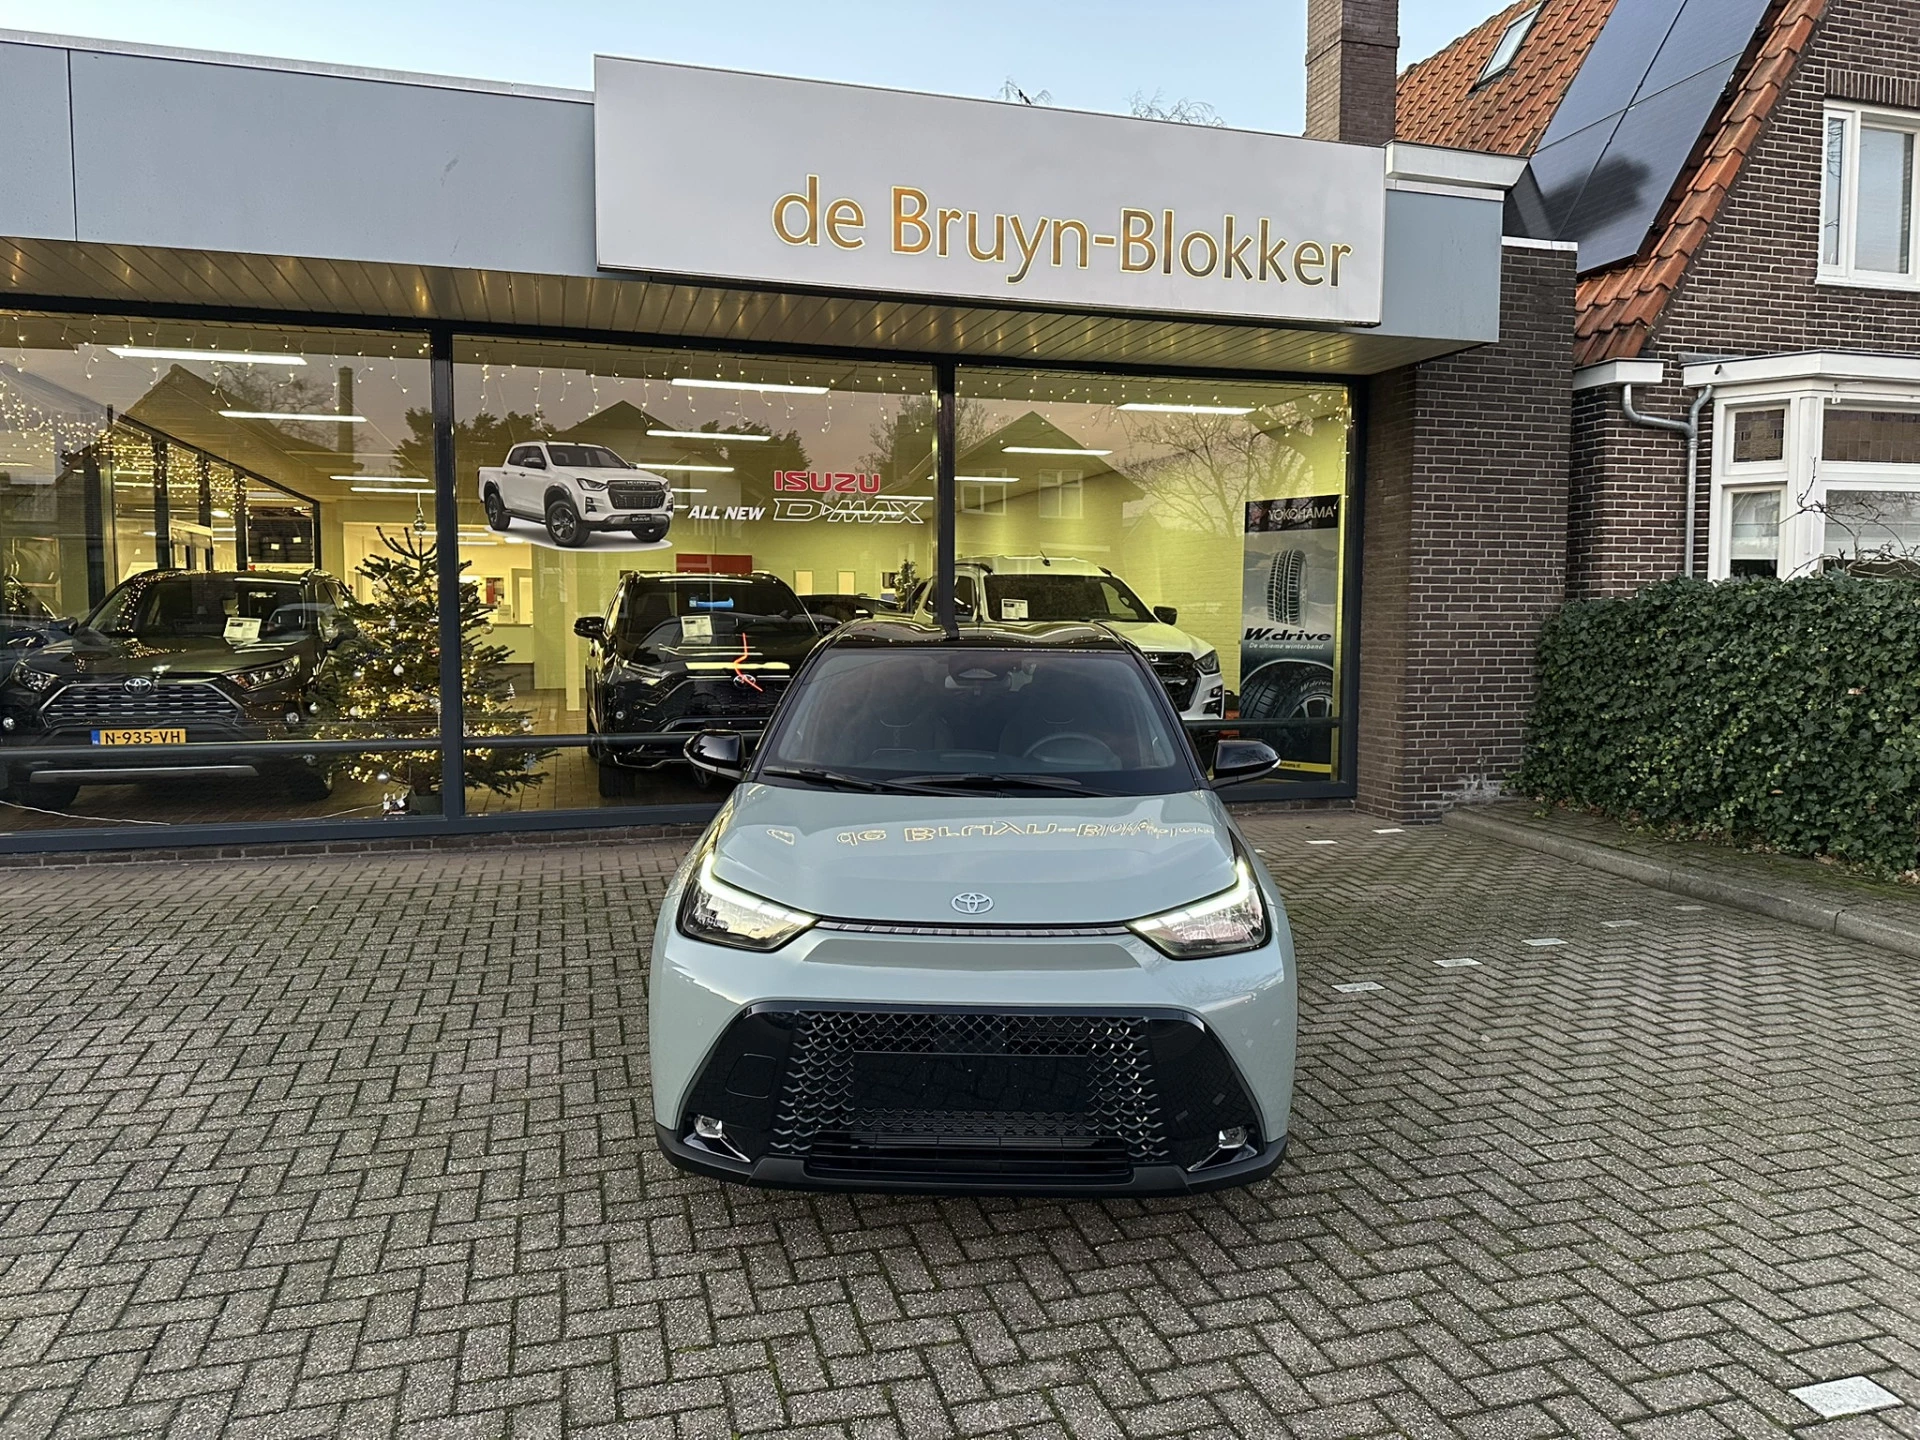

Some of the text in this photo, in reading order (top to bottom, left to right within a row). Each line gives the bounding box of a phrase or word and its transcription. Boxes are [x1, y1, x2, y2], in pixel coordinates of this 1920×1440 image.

[772, 174, 1352, 287] de Bruyn-Blokker
[773, 470, 881, 493] ISUZU
[688, 505, 721, 520] ALL
[724, 505, 766, 520] NEW
[1268, 506, 1334, 520] YOKOHAMA
[1244, 628, 1331, 641] W.drive
[105, 730, 180, 745] N-935-VH
